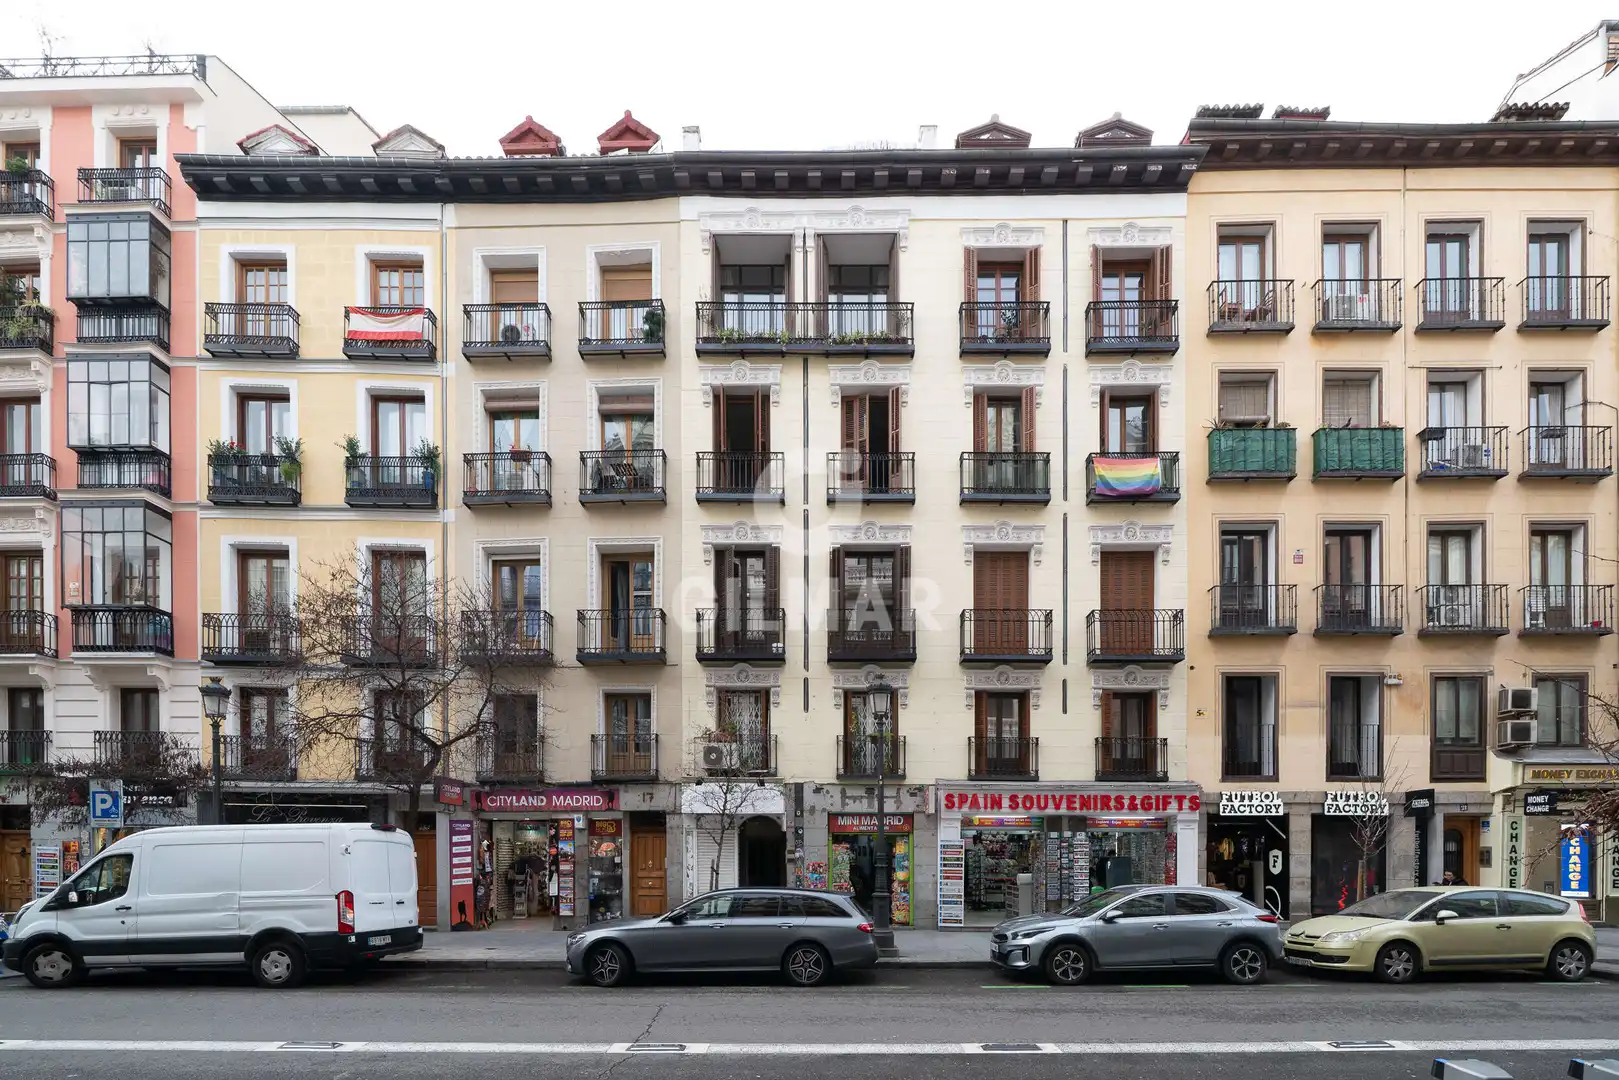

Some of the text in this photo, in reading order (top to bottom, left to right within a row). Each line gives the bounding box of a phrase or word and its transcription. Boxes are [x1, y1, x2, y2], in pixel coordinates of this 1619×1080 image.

[1530, 769, 1572, 779] MONEY
[487, 796, 603, 806] CITYLAND MADRID
[1221, 791, 1281, 803] FUTBOL
[1326, 791, 1387, 803] FUTBOL
[1527, 795, 1549, 803] MONEY
[95, 794, 113, 816] P
[944, 793, 1003, 810] SPAIN
[1008, 793, 1200, 812] SOUVENIRS&GIFTS
[1221, 804, 1282, 814] FACTORY
[1326, 804, 1387, 814] FACTORY
[1526, 804, 1550, 812] CHANGE
[838, 816, 859, 826] MINI
[1509, 821, 1518, 888] CHANGE
[1569, 837, 1581, 889] CHANGE
